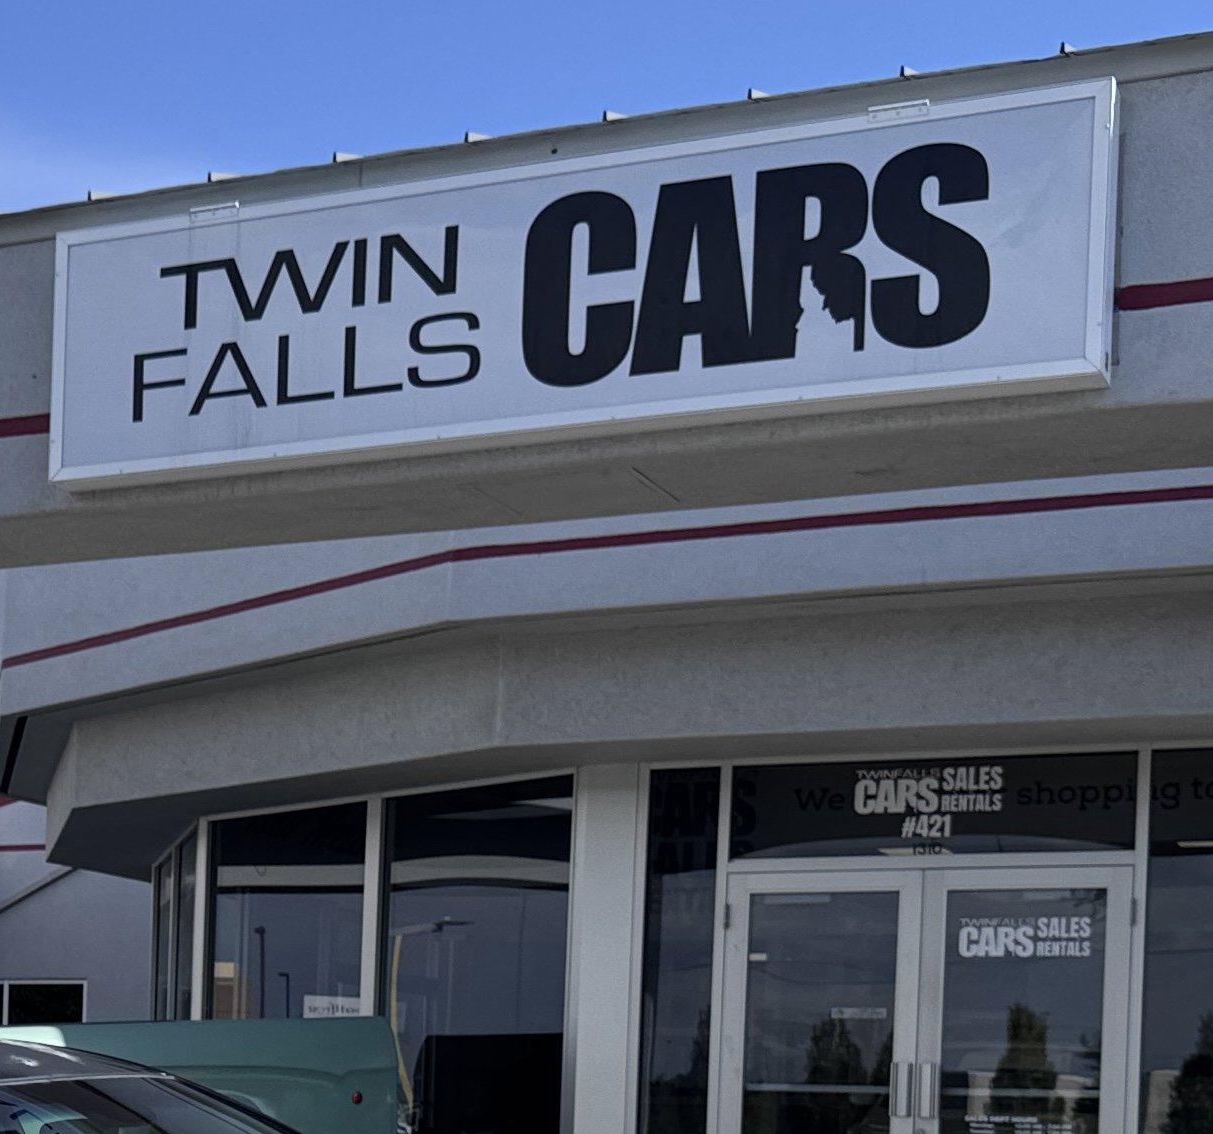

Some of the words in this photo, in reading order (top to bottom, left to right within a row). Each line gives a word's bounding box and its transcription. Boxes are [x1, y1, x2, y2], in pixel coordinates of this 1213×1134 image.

[521, 142, 989, 387] CARS
[160, 226, 458, 329] TWIN
[132, 312, 481, 422] FALLS
[942, 766, 1003, 791] SALES
[793, 787, 844, 812] We
[854, 778, 939, 815] CARS
[941, 792, 1003, 812] RENTALS
[901, 815, 951, 838] #421
[1037, 916, 1091, 938] SALES
[958, 926, 1034, 958] CARS
[1036, 940, 1090, 957] RENTALS
